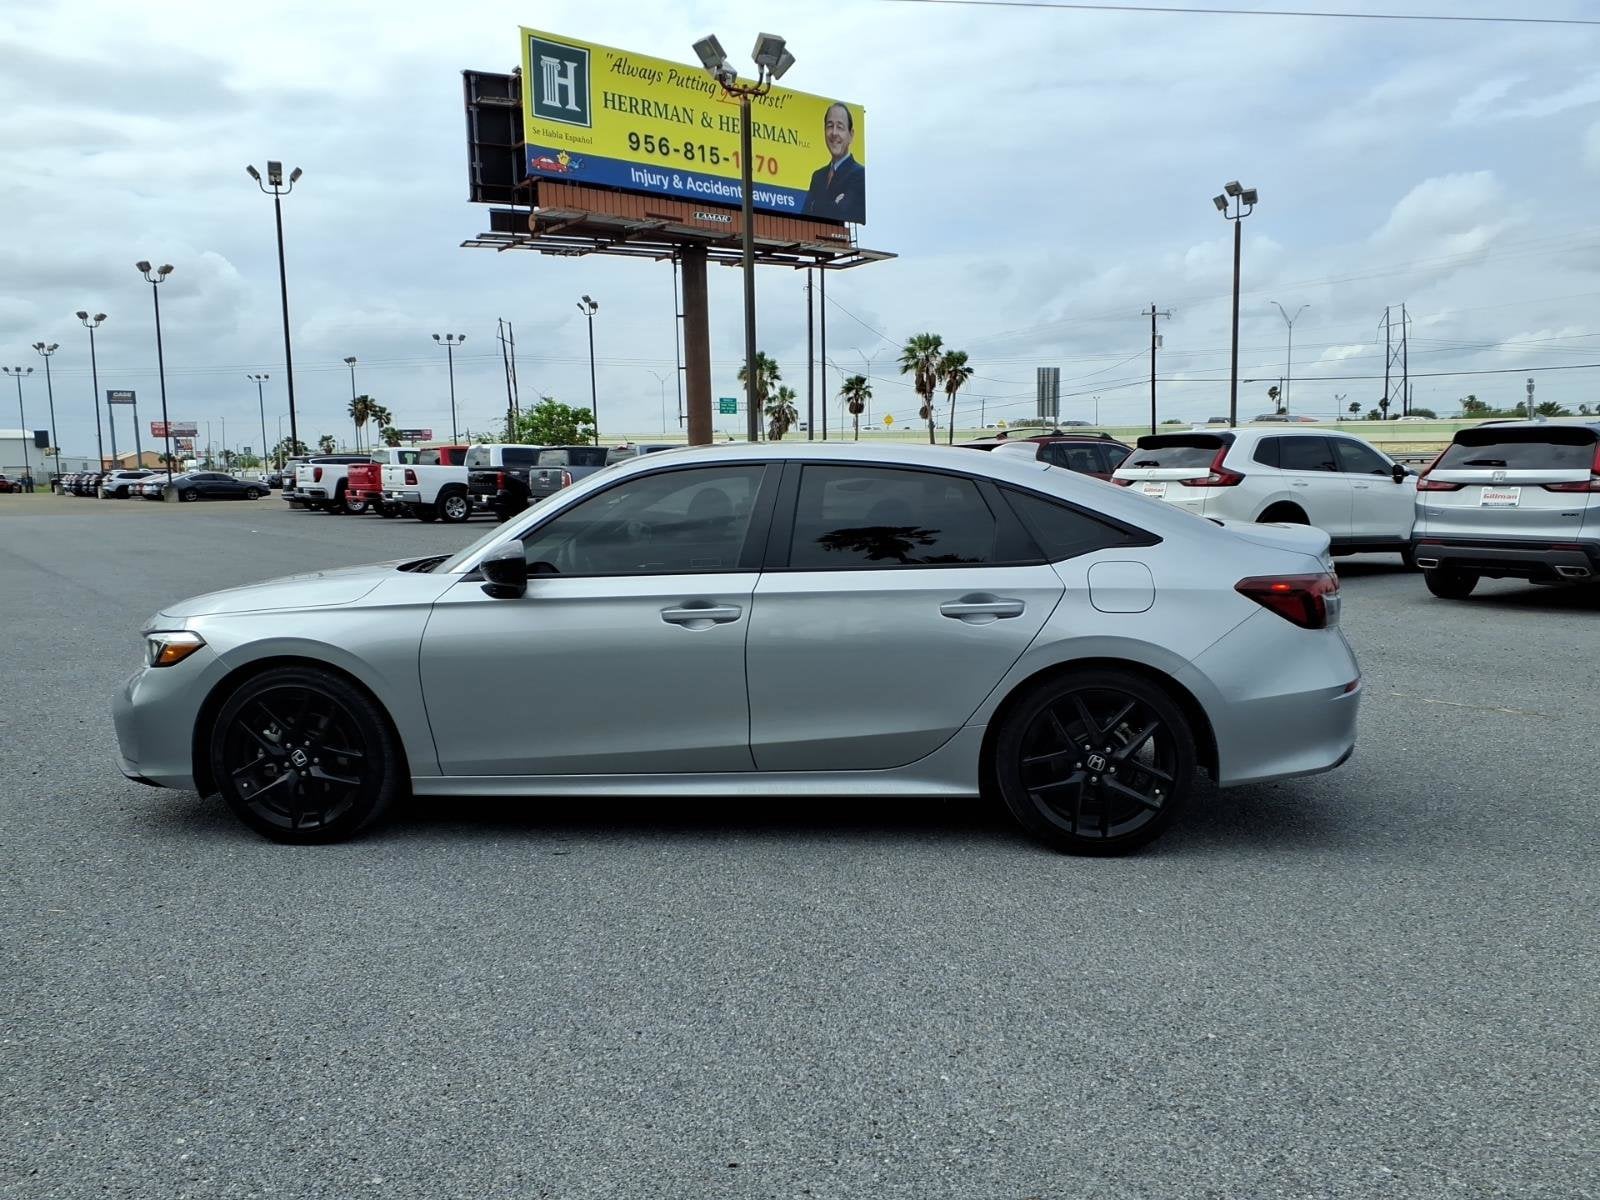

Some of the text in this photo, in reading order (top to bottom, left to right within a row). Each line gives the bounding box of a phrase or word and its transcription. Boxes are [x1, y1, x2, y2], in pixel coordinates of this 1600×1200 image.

[606, 52, 663, 86] "Always
[667, 68, 717, 99] Putting
[532, 126, 593, 144] Se Habla Español
[603, 91, 694, 125] HERRMAN
[701, 111, 713, 128] &
[719, 114, 798, 146] HERMAN
[628, 131, 779, 176] 956-815-170
[631, 167, 795, 207] Injury & Accident awyers
[695, 212, 730, 223] LAMAR
